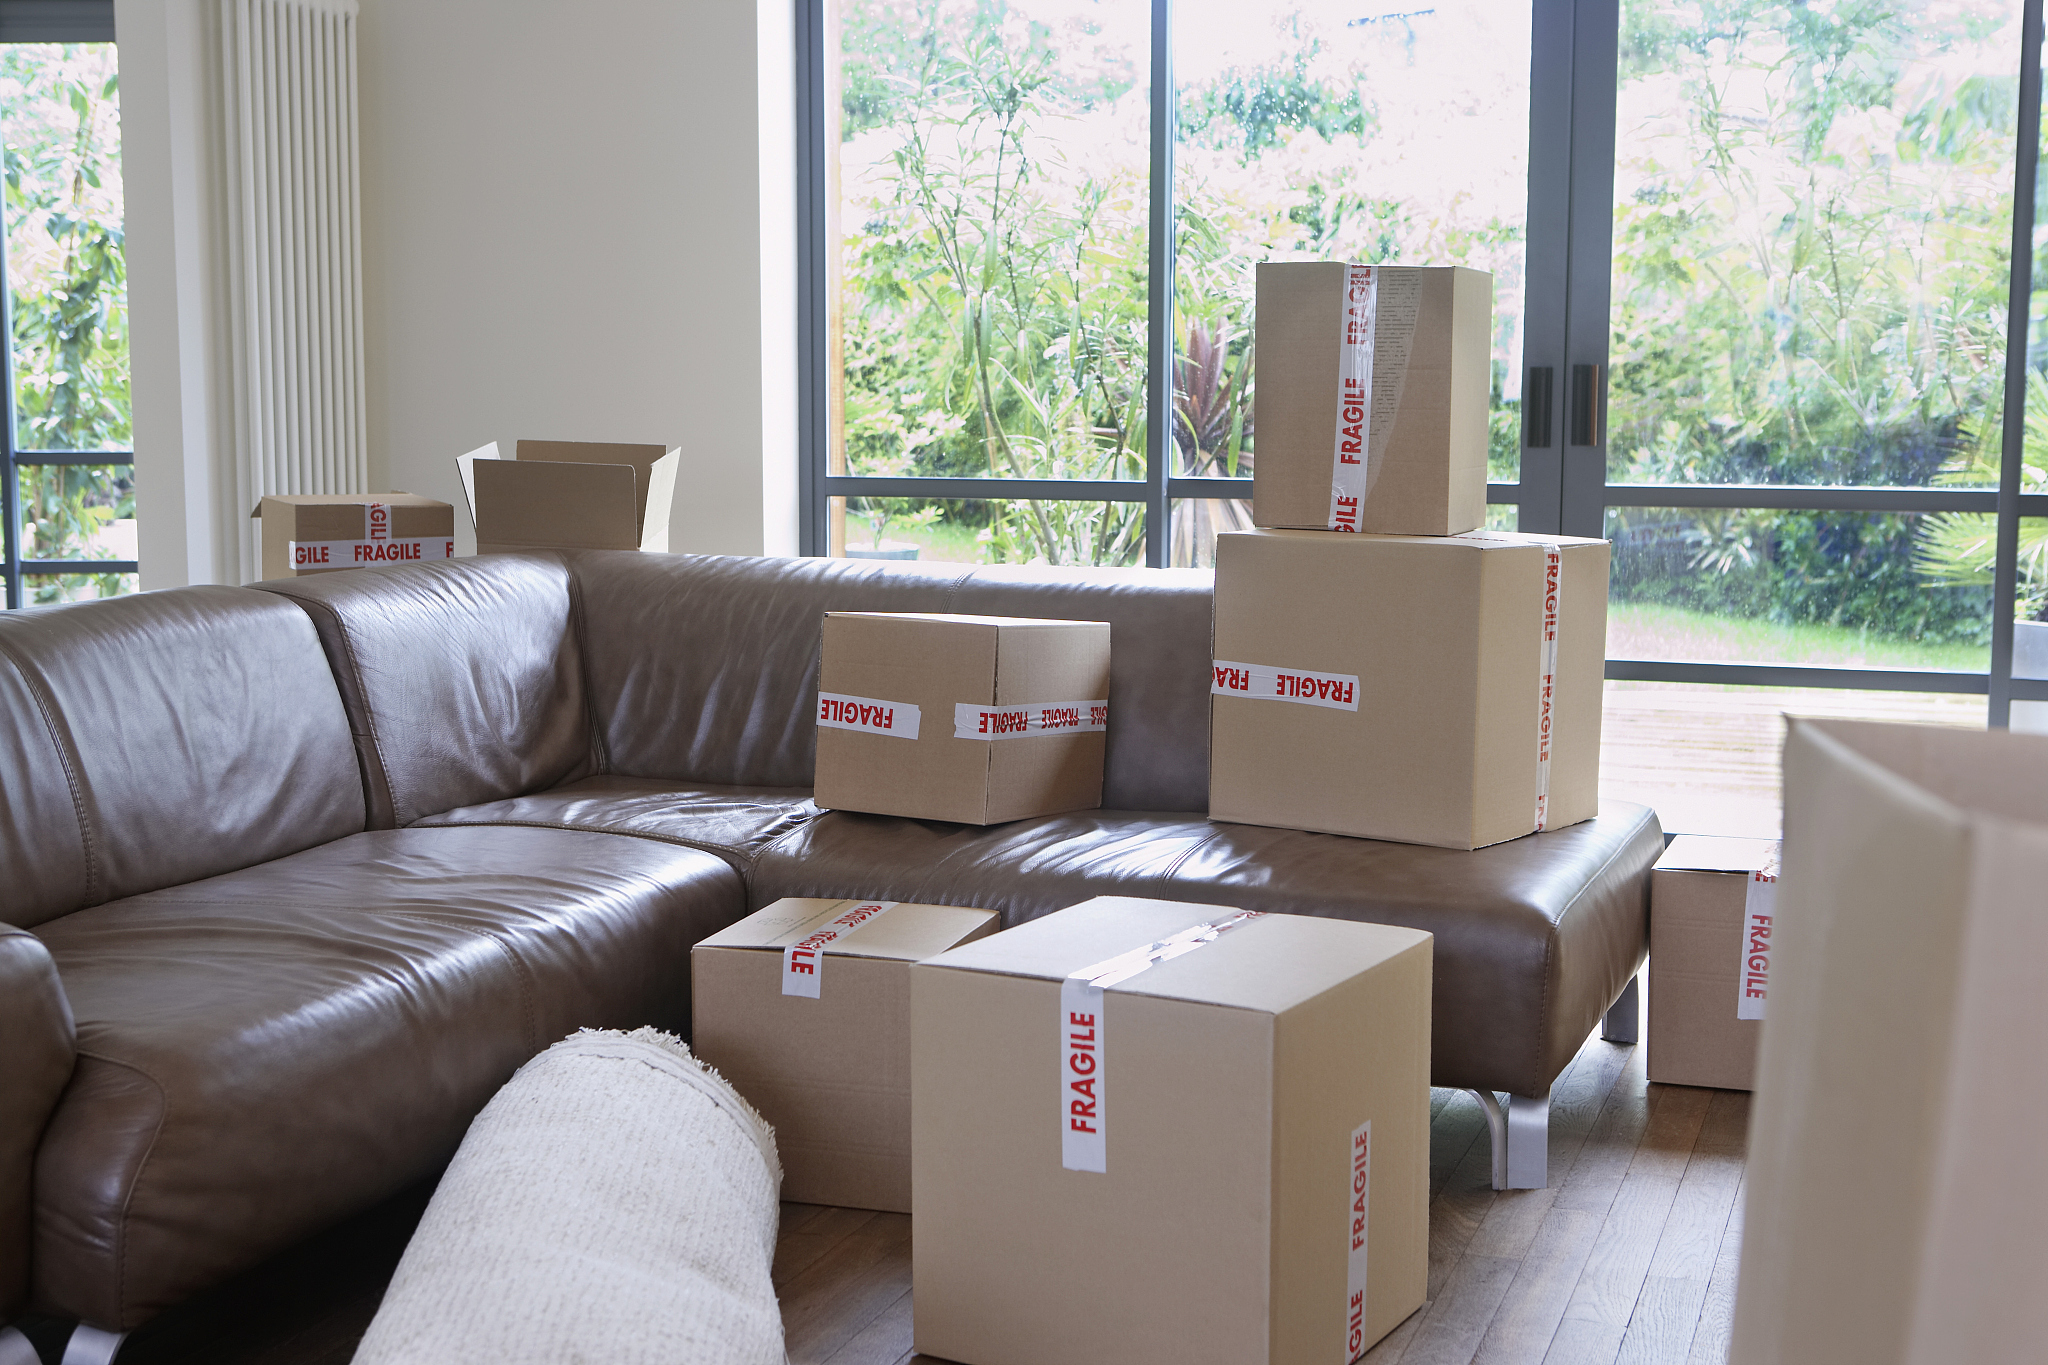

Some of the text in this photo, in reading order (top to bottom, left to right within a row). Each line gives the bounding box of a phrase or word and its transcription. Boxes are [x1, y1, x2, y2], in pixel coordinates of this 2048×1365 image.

[1340, 378, 1365, 465] FRAGILE
[354, 543, 421, 562] FRAGILE
[1544, 553, 1559, 641] FRAGILE
[820, 699, 894, 729] FRAGILE
[979, 711, 1028, 733] FRAGILE
[1041, 708, 1079, 729] FRAGILE
[1212, 667, 1353, 703] FRAGILE FRA
[1540, 674, 1554, 762] FRAGILE
[1746, 914, 1773, 999] FRAGILE
[1070, 1012, 1097, 1134] FRAGILE
[1352, 1131, 1367, 1251] FRAGILE
